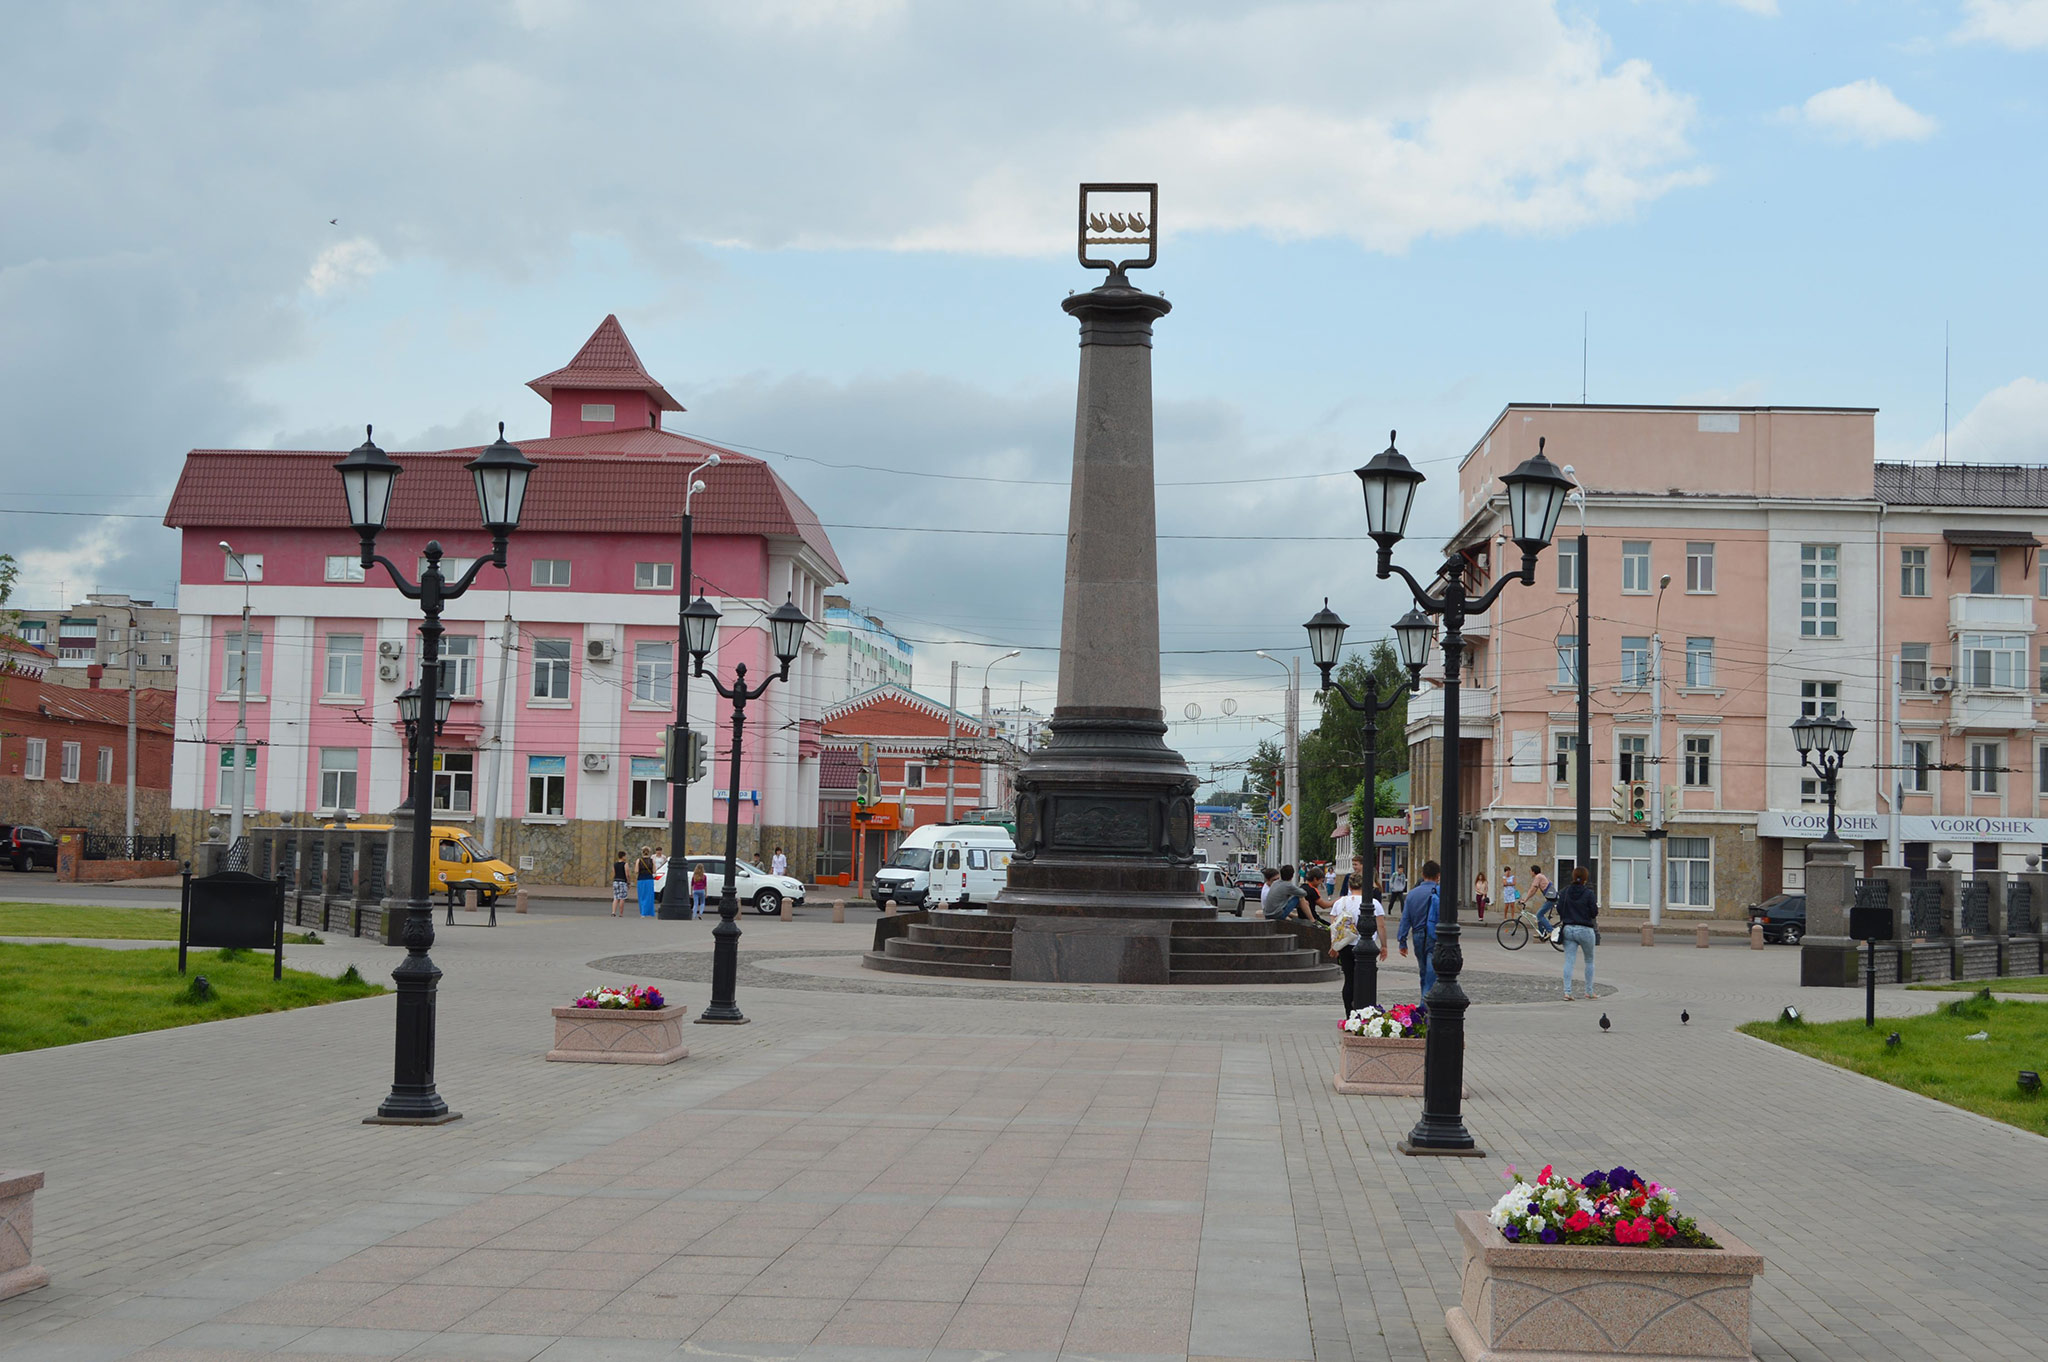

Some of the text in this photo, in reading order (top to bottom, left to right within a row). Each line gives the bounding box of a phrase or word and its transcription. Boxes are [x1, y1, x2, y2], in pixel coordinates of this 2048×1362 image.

[1538, 821, 1548, 829] 57
[1782, 815, 1877, 830] VGOROSHEK
[1931, 818, 2034, 834] VGOROSHEK
